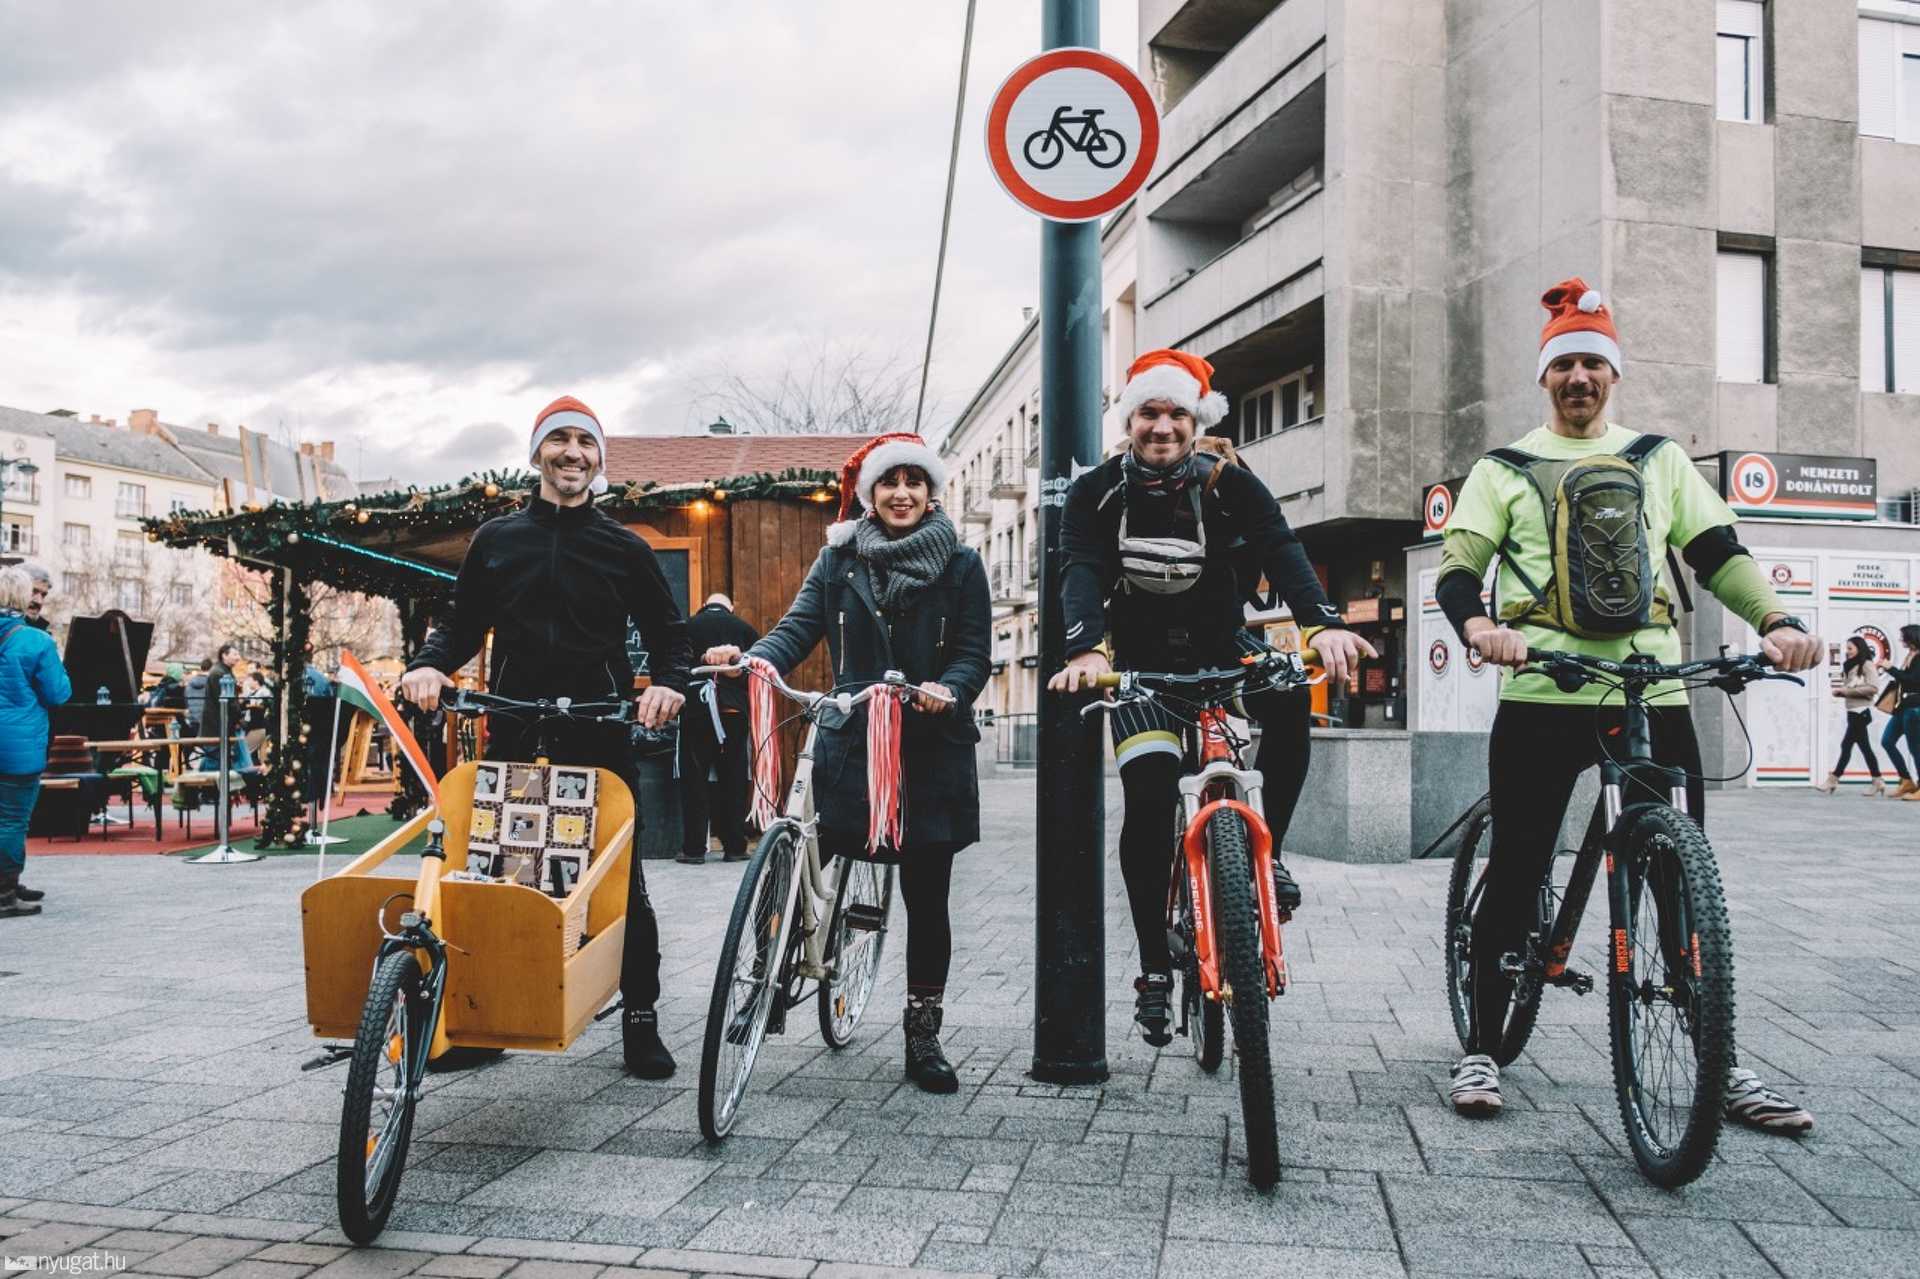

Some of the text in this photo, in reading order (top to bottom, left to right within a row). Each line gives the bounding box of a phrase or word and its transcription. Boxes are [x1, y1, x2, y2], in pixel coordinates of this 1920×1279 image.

[1745, 471, 1764, 488] 18
[1799, 466, 1860, 480] NEMZETI
[1785, 480, 1873, 496] DOHÁNYBOLT
[1433, 502, 1444, 517] 18
